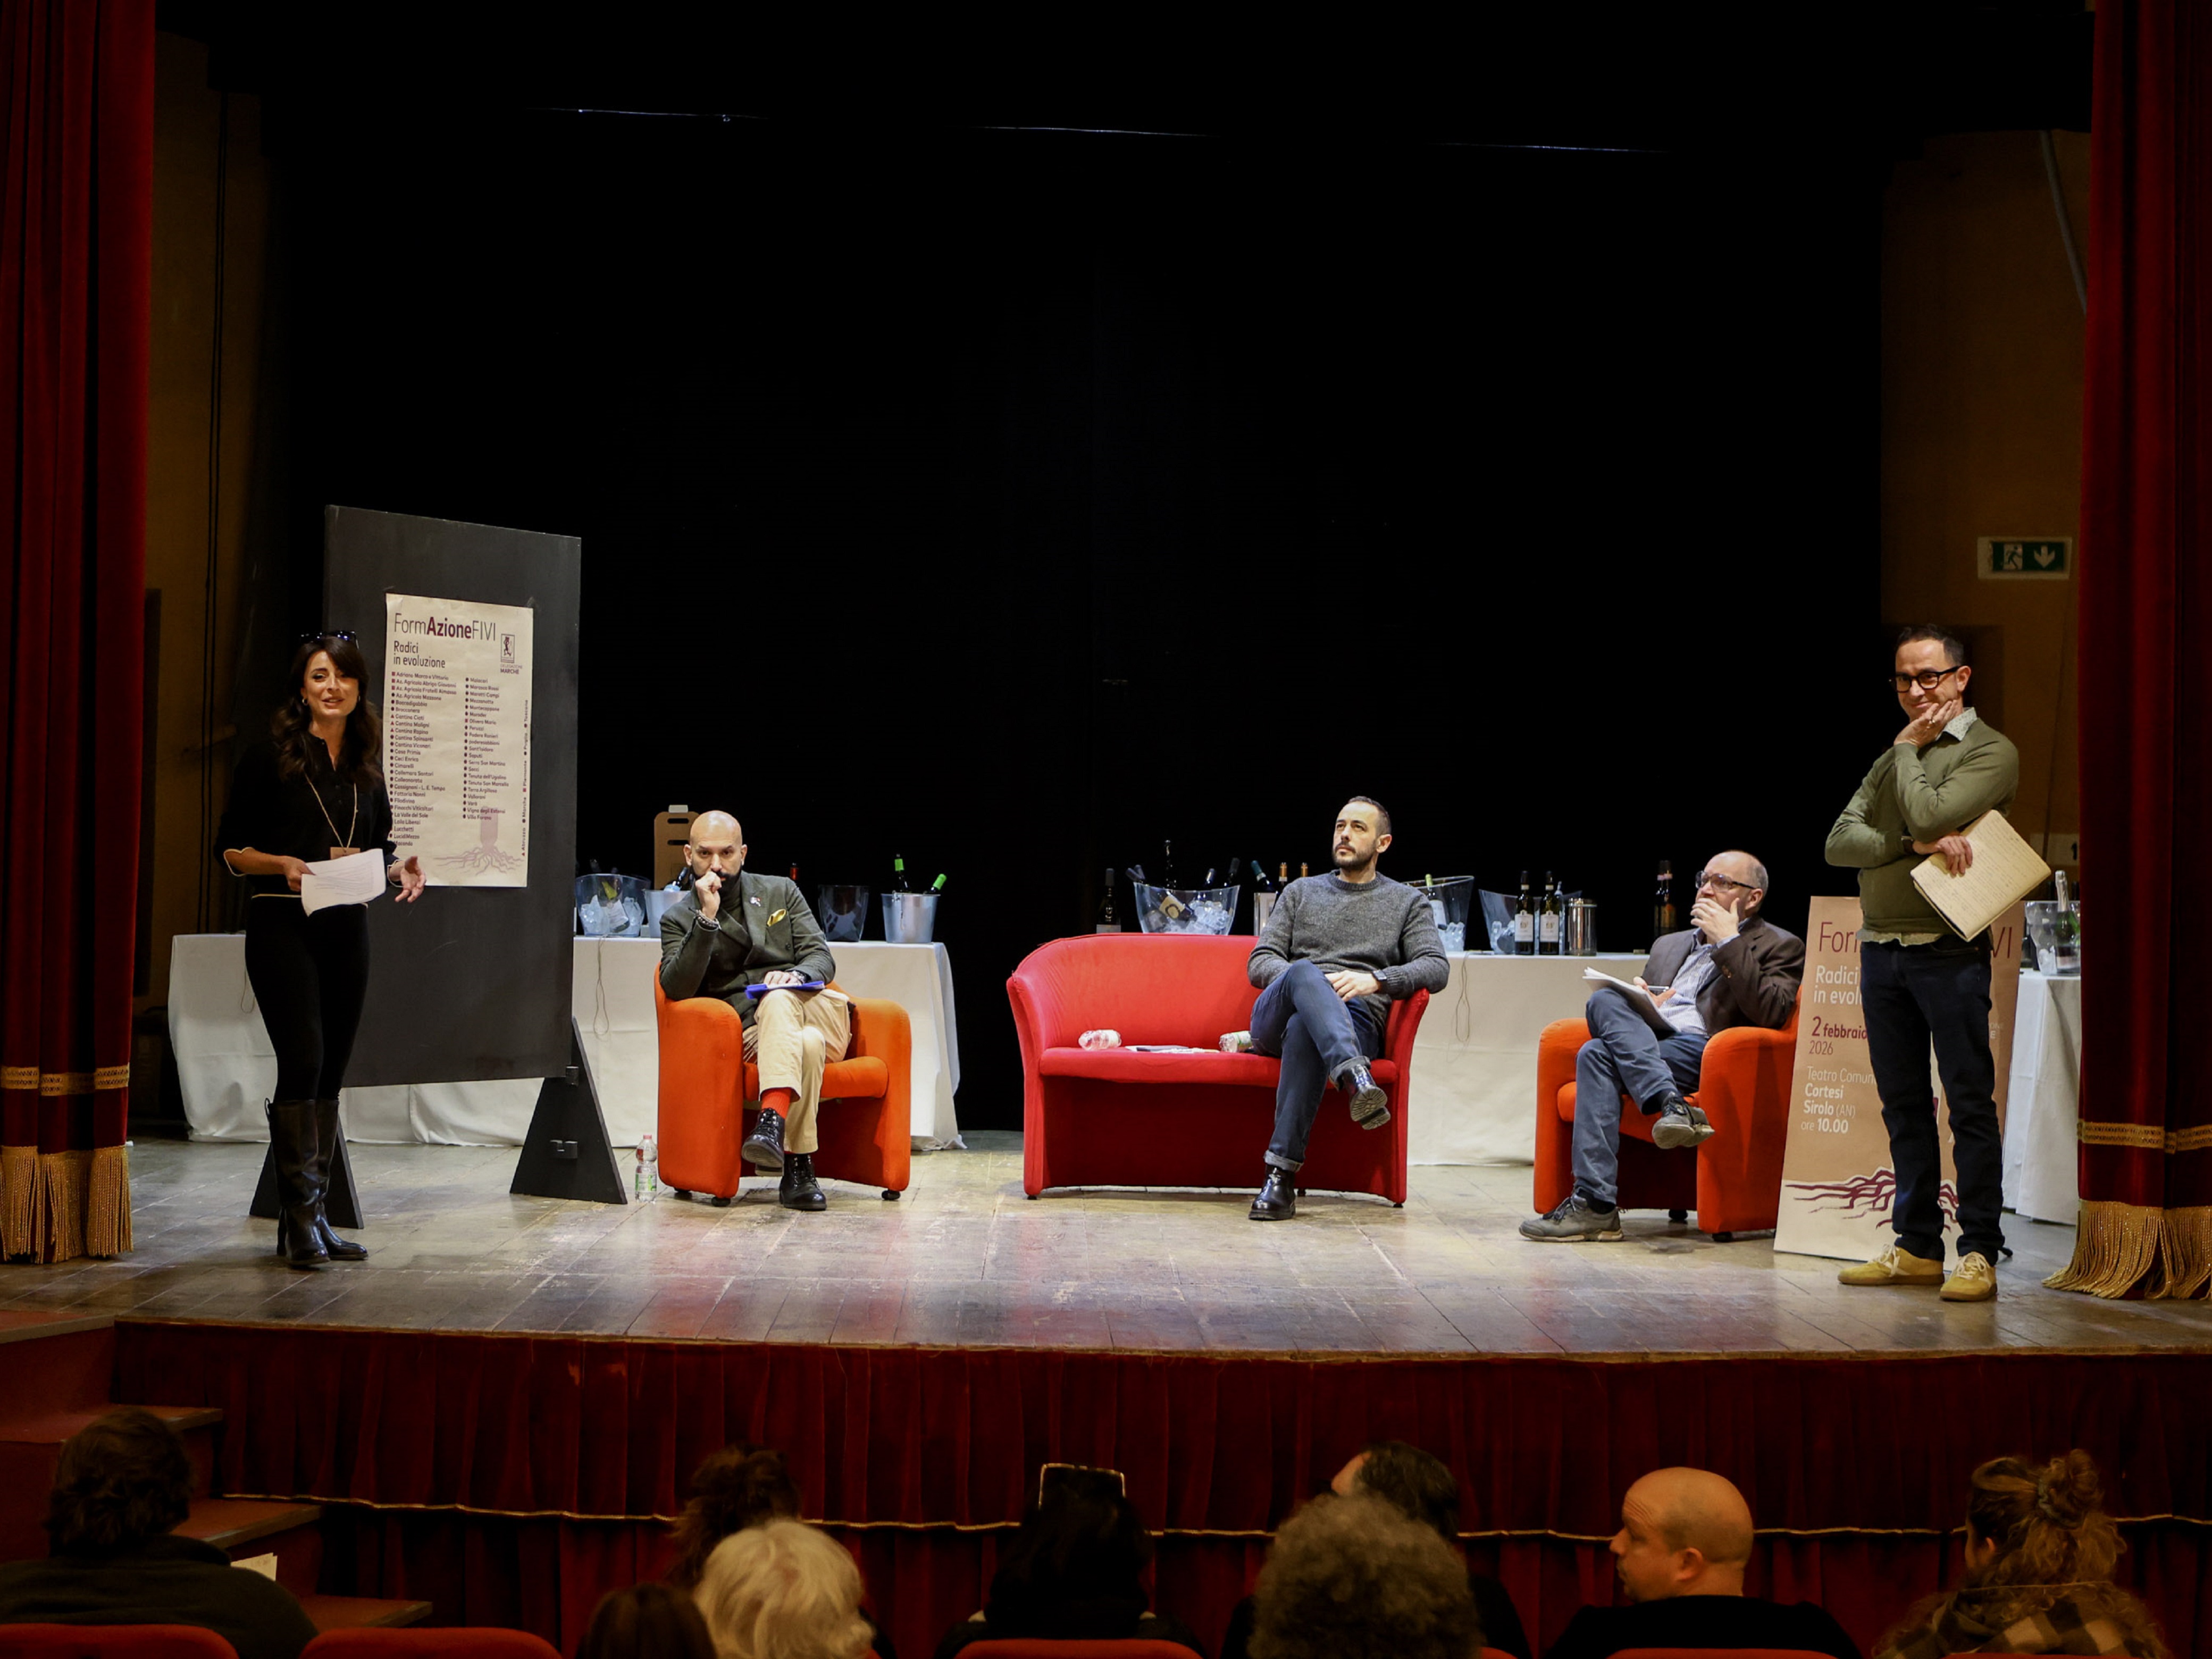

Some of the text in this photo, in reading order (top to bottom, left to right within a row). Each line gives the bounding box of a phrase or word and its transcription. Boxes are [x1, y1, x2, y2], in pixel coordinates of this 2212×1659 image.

[394, 613, 496, 641] FormAzioneFIVI
[394, 641, 418, 653] Radici
[393, 653, 446, 668] in evoluzione
[1815, 965, 1859, 985] Radici
[1814, 985, 1826, 1004] in
[1812, 1016, 1822, 1037] 2
[1809, 1040, 1833, 1055] 2026
[1807, 1065, 1837, 1082] Teatro
[1805, 1083, 1844, 1099] Cortesi
[1803, 1100, 1856, 1119] Sirolo (AN)
[1801, 1118, 1848, 1134] ore 10.00
